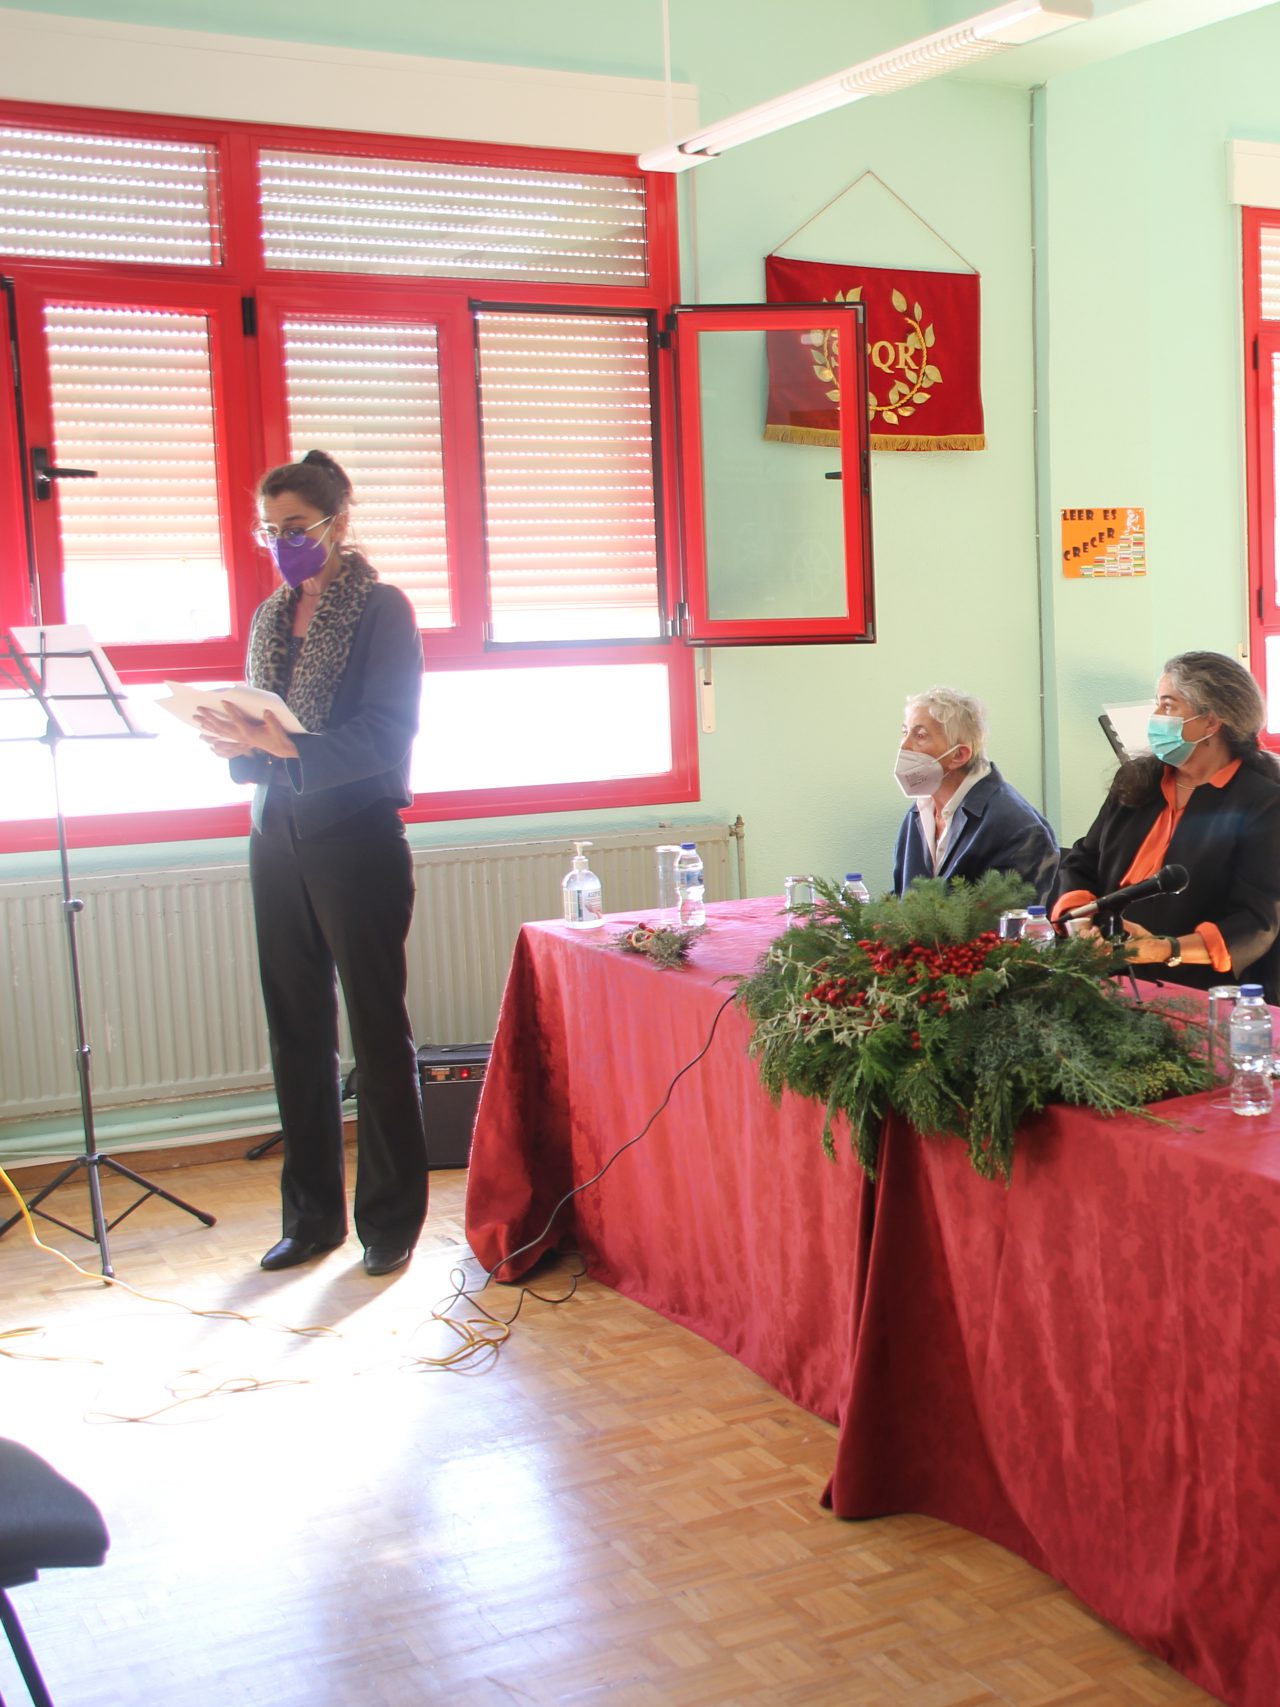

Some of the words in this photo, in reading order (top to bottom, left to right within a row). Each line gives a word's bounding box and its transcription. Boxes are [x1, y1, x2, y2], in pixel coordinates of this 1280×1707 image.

[832, 340, 919, 373] QR
[1063, 509, 1094, 521] LEER
[1103, 509, 1117, 521] ES
[1064, 528, 1115, 561] CRECER
